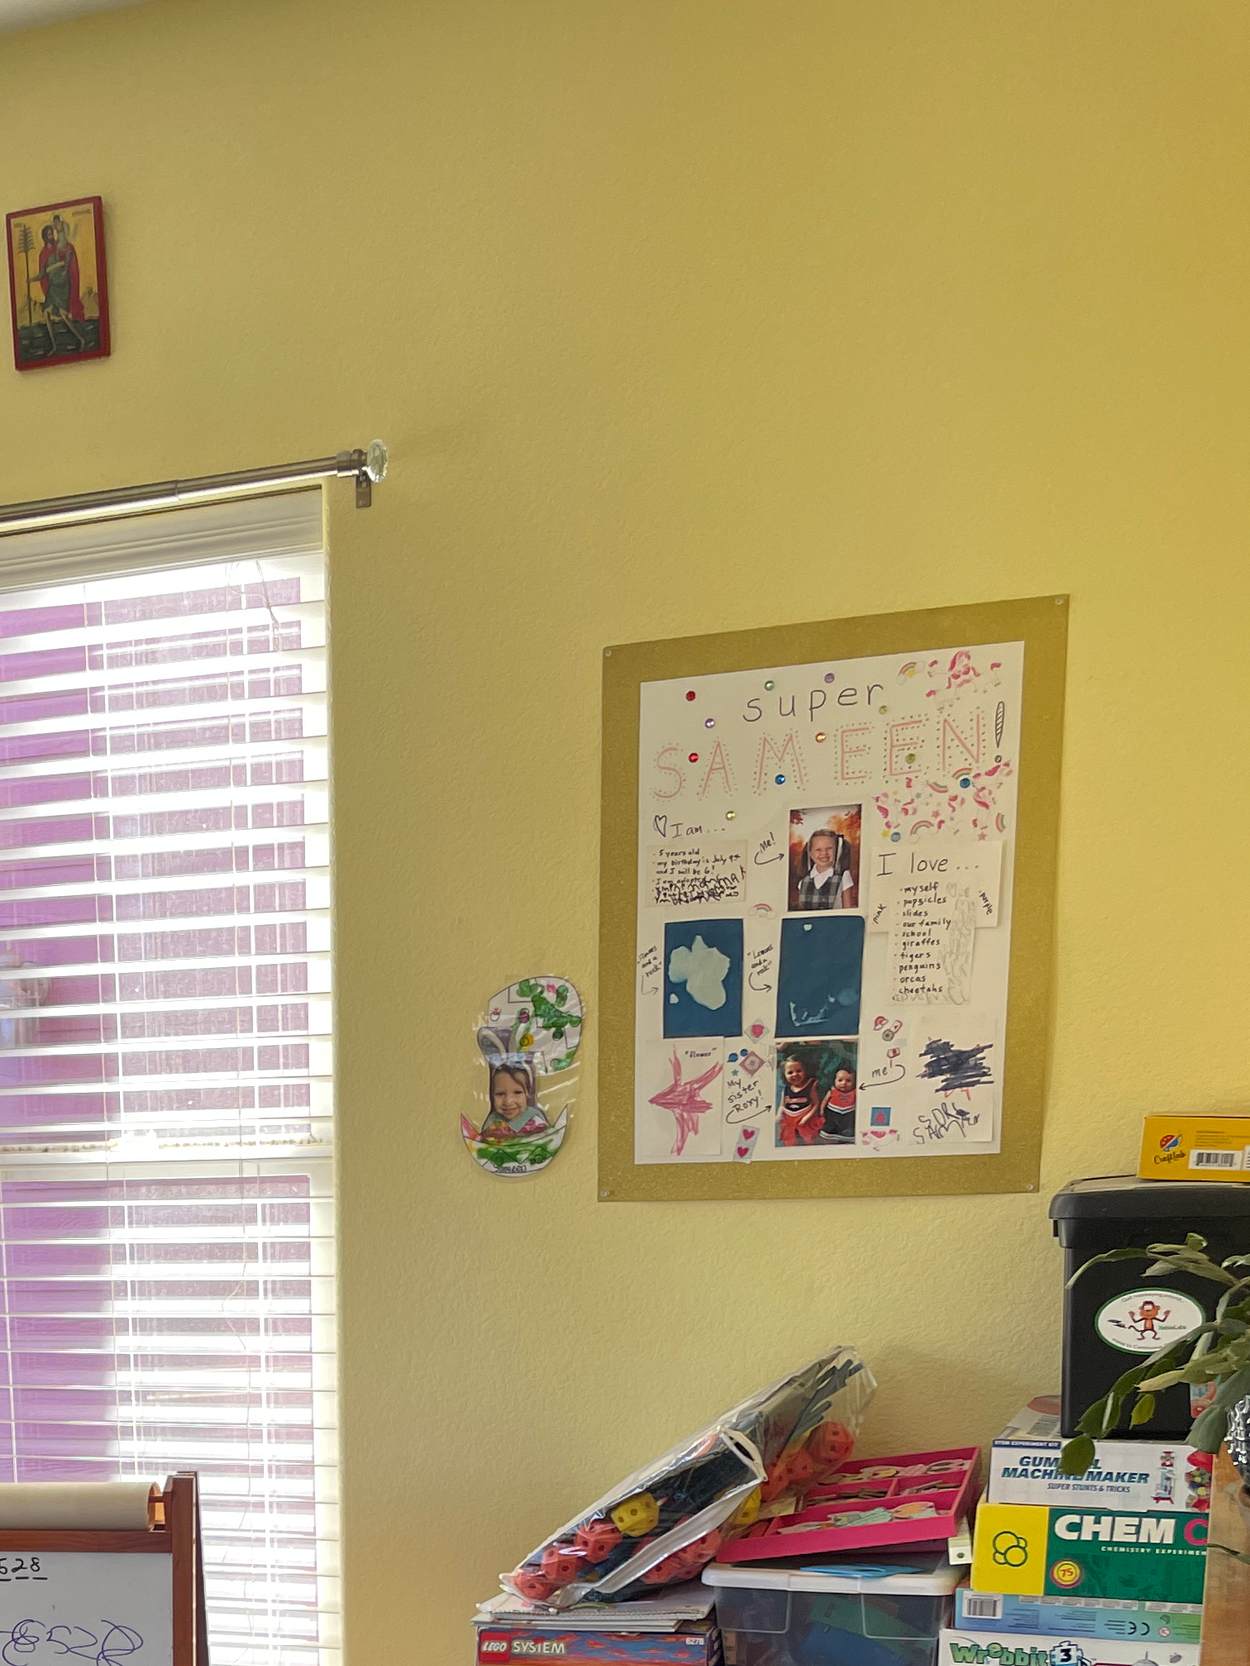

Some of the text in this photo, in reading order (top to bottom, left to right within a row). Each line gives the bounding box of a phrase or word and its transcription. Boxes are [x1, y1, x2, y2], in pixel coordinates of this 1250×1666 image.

[743, 682, 885, 723] super
[876, 853, 896, 877] I
[904, 882, 939, 895] myself
[903, 893, 947, 907] popsicles
[902, 909, 928, 917] slides
[920, 918, 951, 930] family
[902, 929, 931, 937] school
[902, 938, 940, 950] giraffes
[900, 951, 931, 962] tigers
[899, 962, 941, 974] penguins
[900, 975, 926, 983] orcas
[899, 983, 943, 994] cheetahs
[727, 1081, 759, 1103] sister
[1001, 1468, 1150, 1483] MACHINE MAKER
[1072, 1484, 1097, 1492] STUNTS
[1106, 1485, 1130, 1493] TRICKS
[1054, 1514, 1176, 1544] CHEM
[1060, 1567, 1074, 1578] 75
[482, 1642, 507, 1652] LEGO
[511, 1641, 565, 1655] SYSTEM
